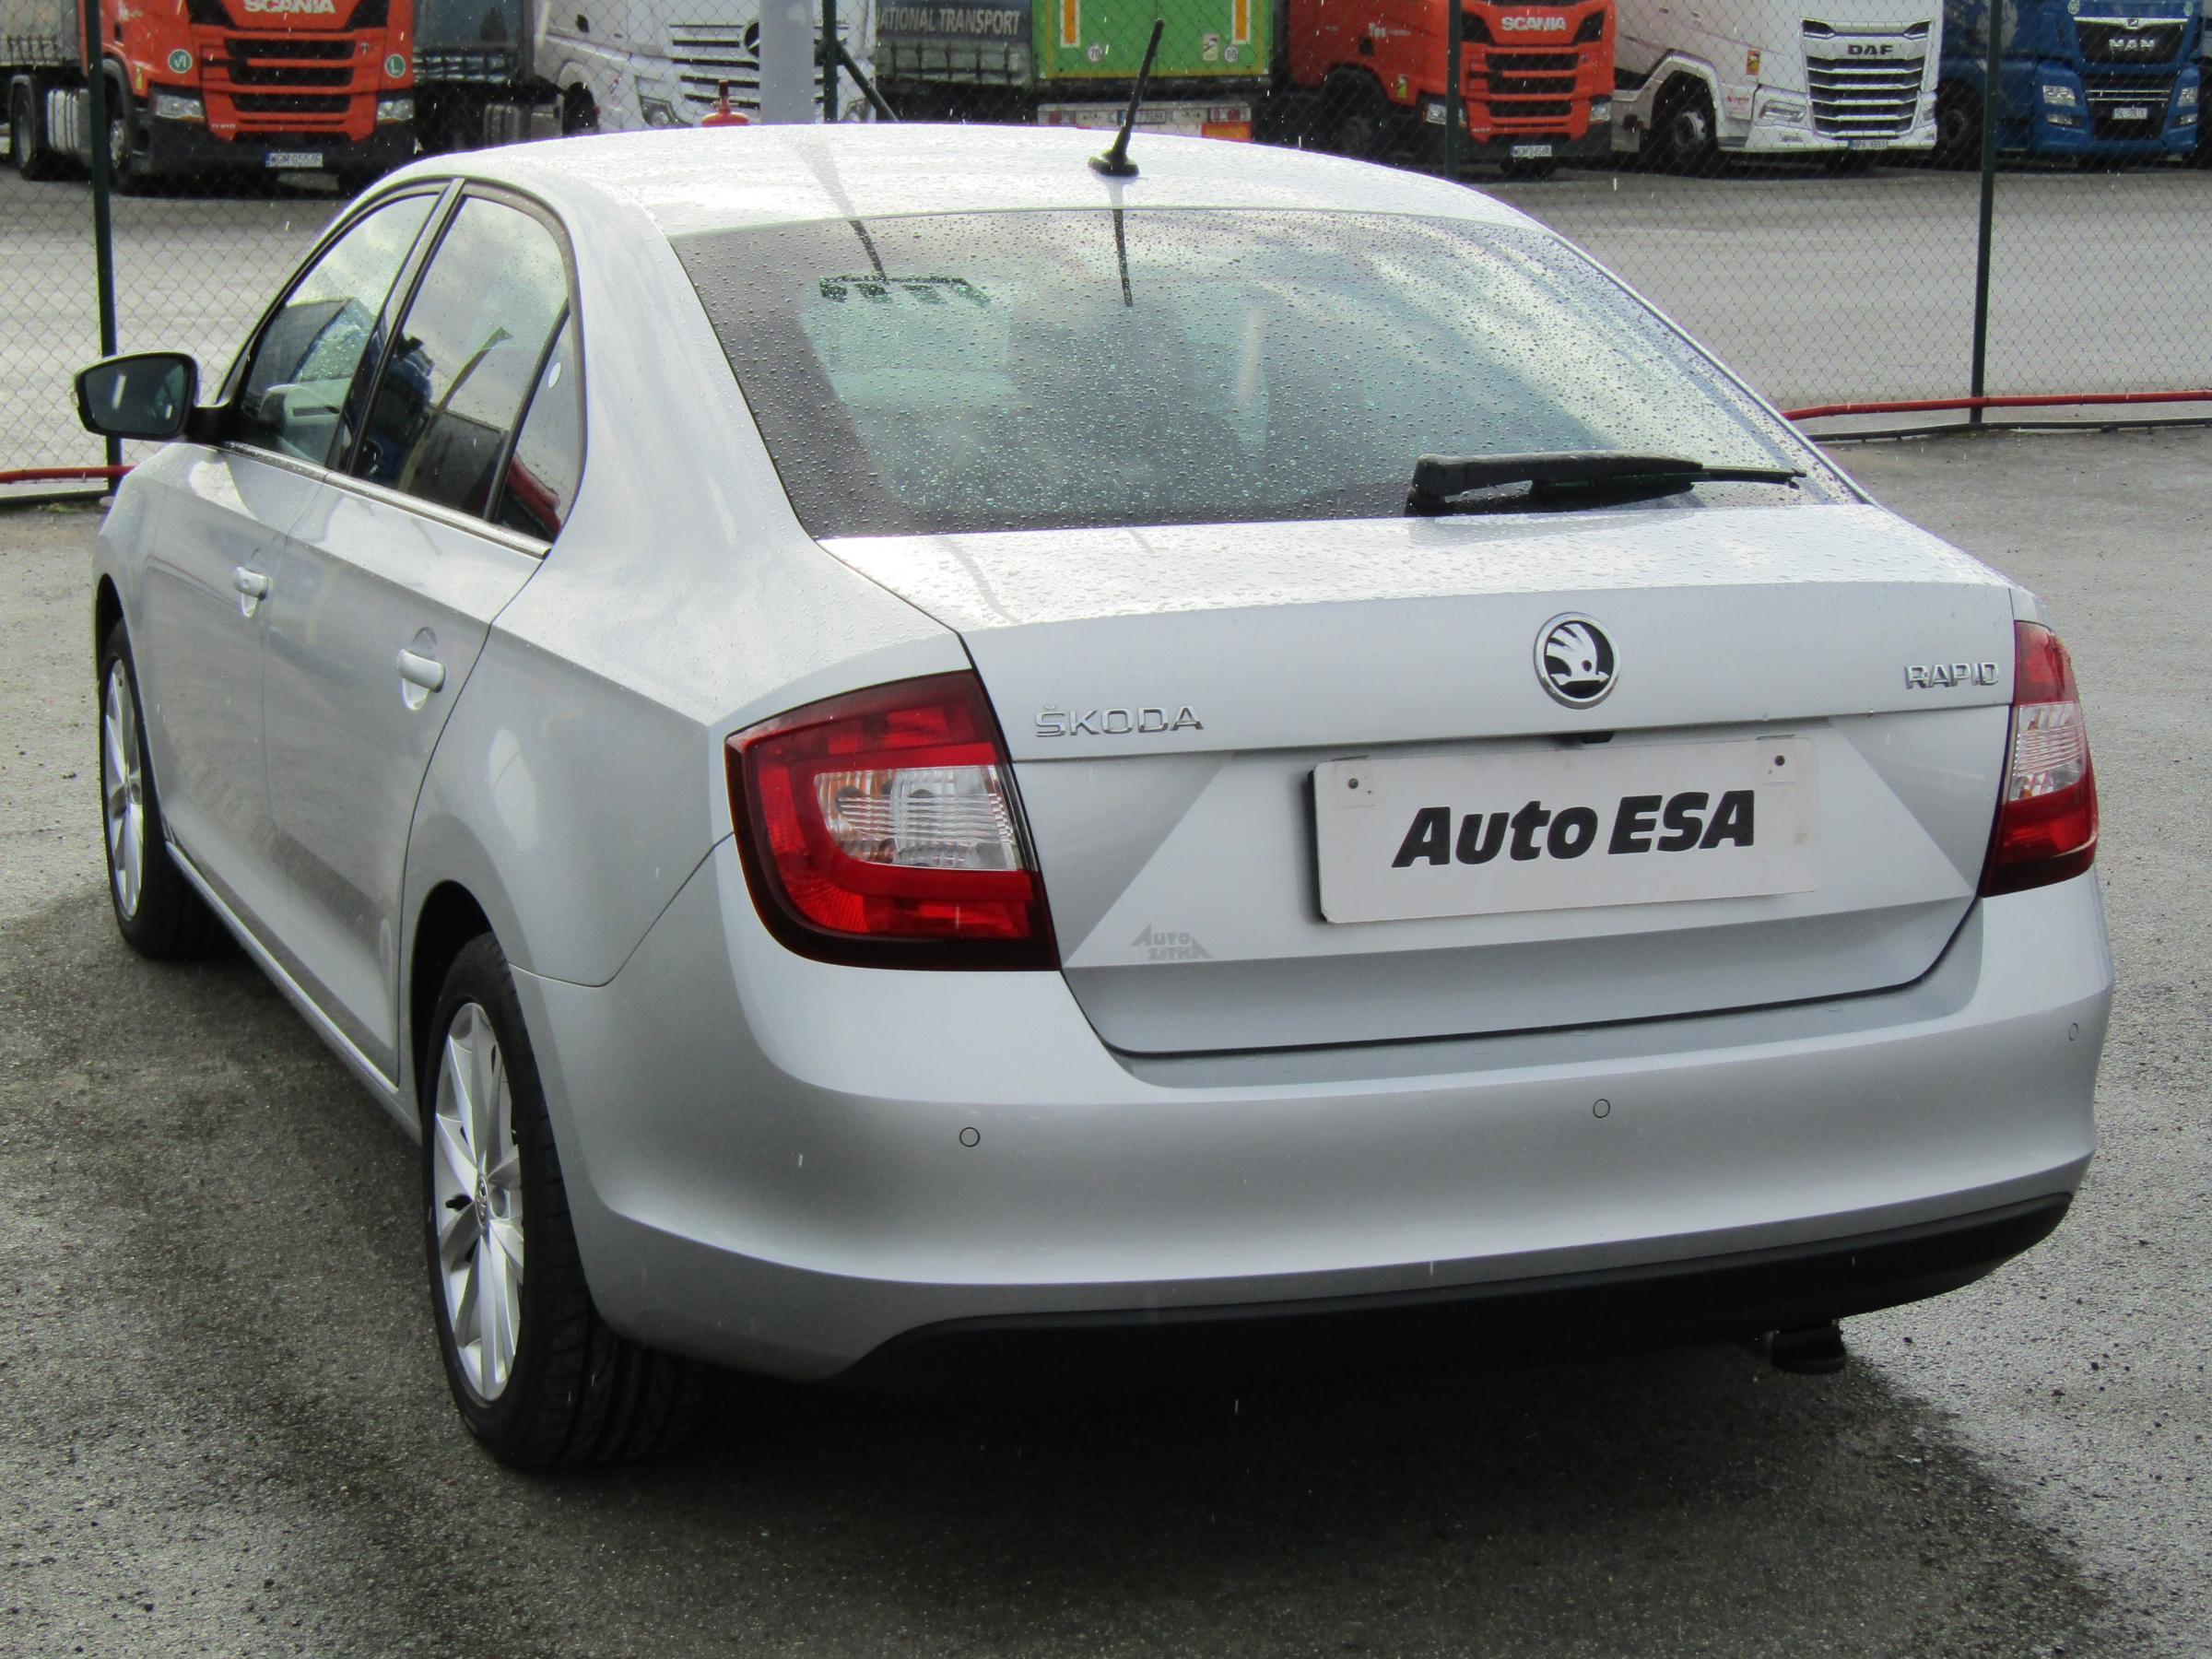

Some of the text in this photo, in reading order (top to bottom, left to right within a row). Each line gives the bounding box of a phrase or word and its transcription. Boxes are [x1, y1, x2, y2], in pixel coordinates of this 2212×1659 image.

[243, 0, 336, 14] SCANIA
[940, 8, 1021, 36] TRANSPORT
[1501, 17, 1567, 31] SCANIA
[1847, 44, 1894, 55] DAF
[2109, 38, 2155, 51] MAN
[1904, 662, 1999, 689] RAPID
[1034, 705, 1205, 737] ŠKODA
[1391, 789, 1755, 868] Auto ESA
